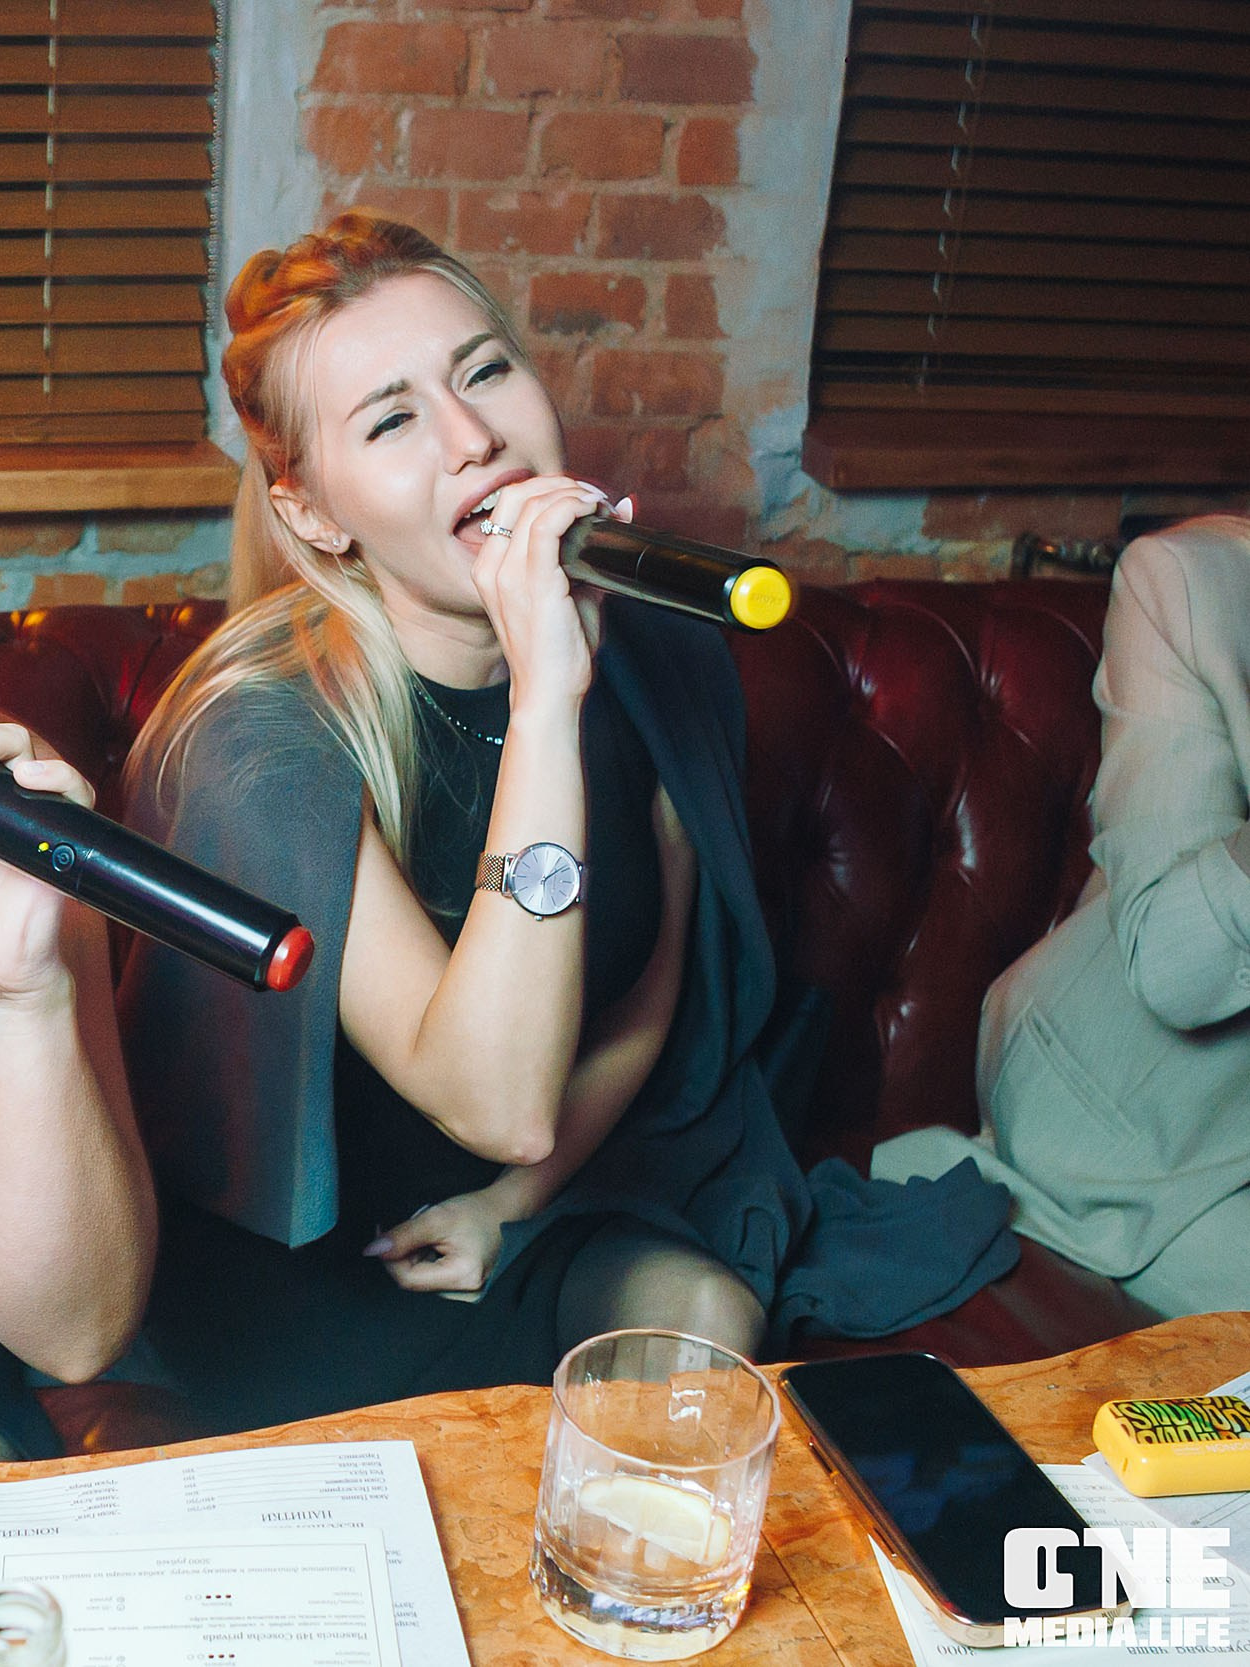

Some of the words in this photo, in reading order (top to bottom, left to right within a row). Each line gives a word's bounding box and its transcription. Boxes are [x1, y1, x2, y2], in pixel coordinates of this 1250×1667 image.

[261, 1510, 333, 1523] НАПИТКИ
[202, 1631, 244, 1643] privada
[1126, 1646, 1170, 1656] чаша
[1174, 1640, 1250, 1655] руктовая
